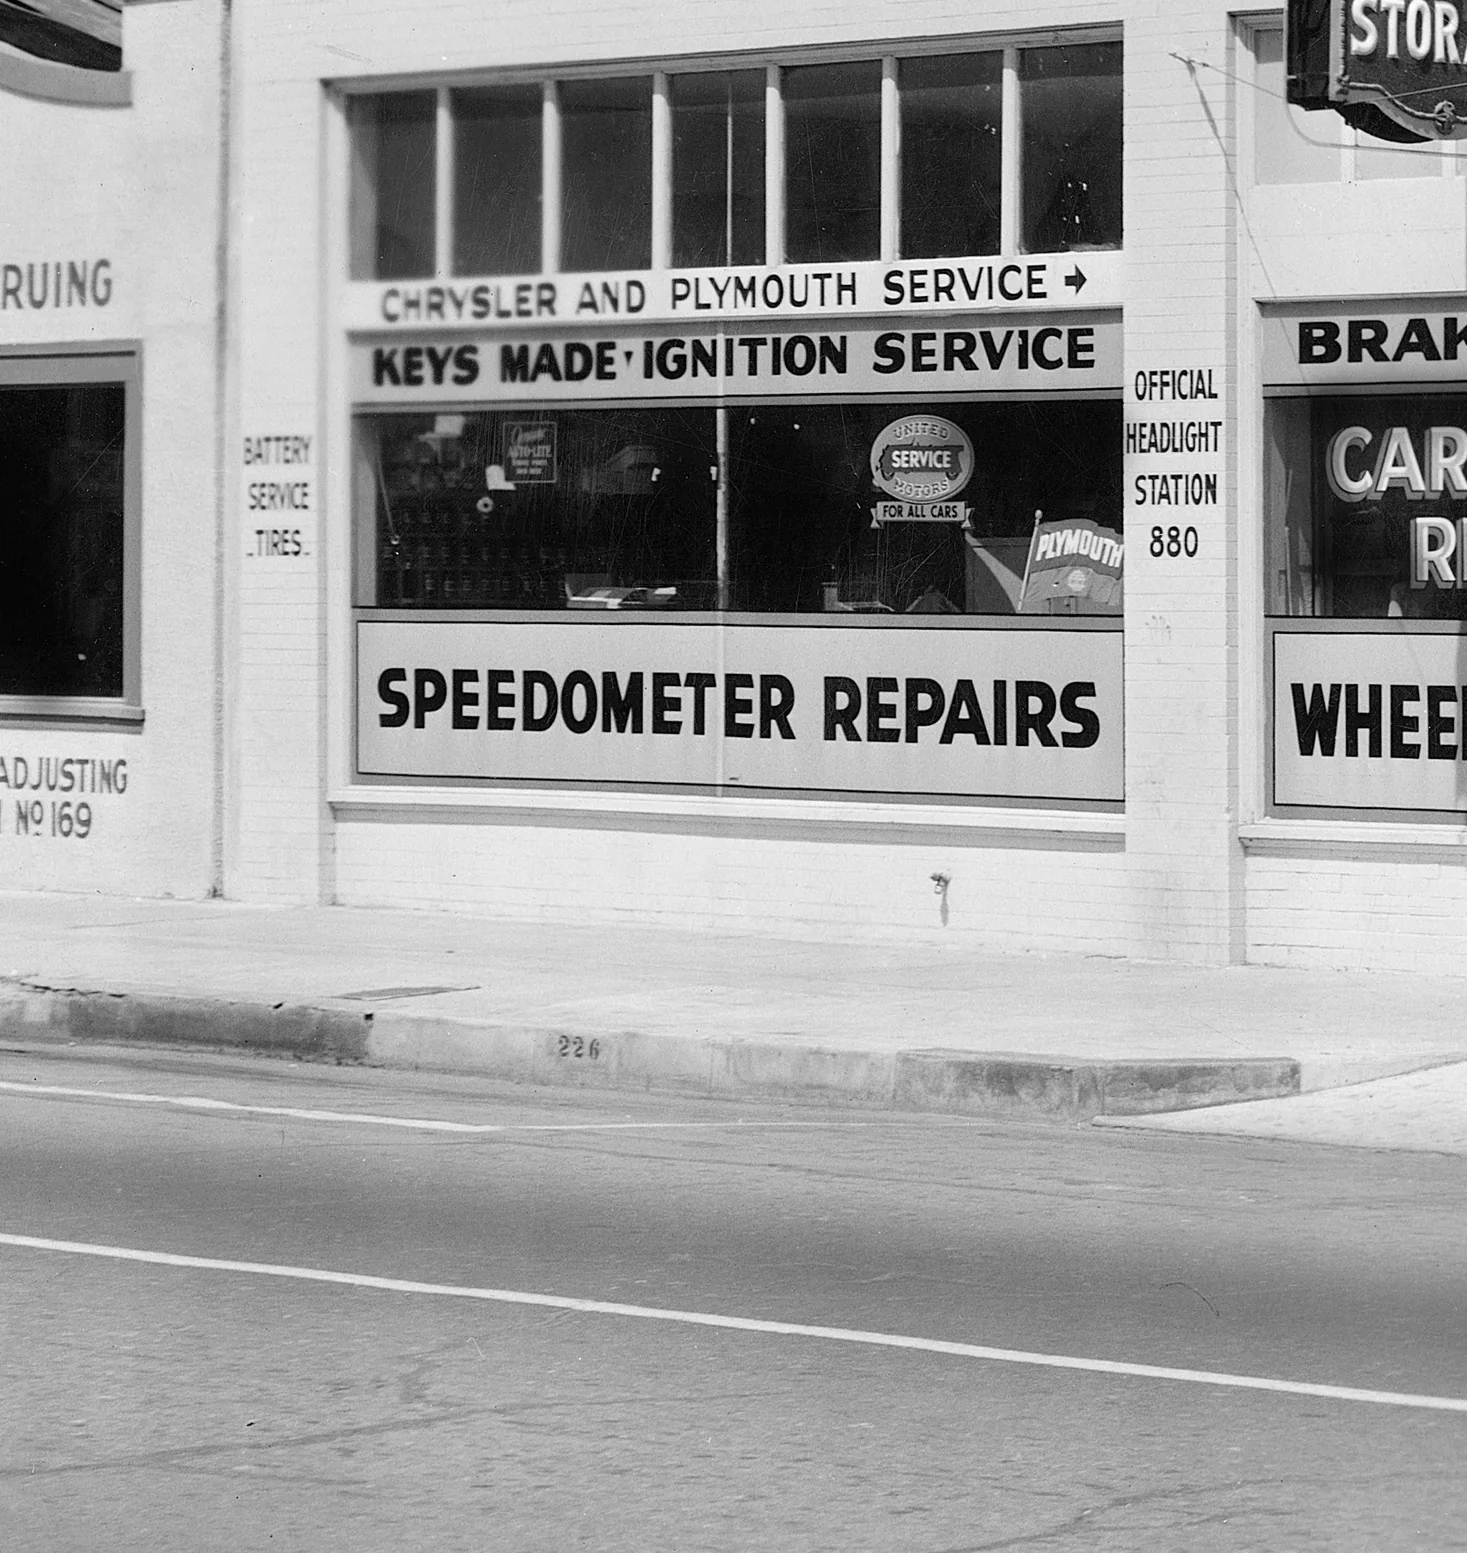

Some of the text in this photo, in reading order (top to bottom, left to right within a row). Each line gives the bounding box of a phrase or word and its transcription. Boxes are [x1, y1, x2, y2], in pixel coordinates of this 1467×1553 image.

[1, 259, 113, 310] RUING
[381, 263, 1048, 324] CHRYSLER AND PLYMOUTH SERVICE
[371, 326, 1096, 387] KEYS MADE IGNITION SERVICE
[1134, 368, 1219, 401] OFFICIAL
[892, 421, 950, 440] UNITED
[1126, 421, 1223, 454] HEADLIGHT
[242, 435, 313, 466] BATTERY
[890, 449, 953, 469] SERVICE
[247, 481, 310, 511] SERVICE
[893, 478, 950, 498] MOTORS
[1134, 473, 1218, 506] STATION
[882, 504, 958, 519] FOR ALL CARS
[1035, 528, 1124, 568] PLYMOUTH
[1149, 525, 1199, 558] 880
[377, 667, 1101, 749] SPEEDOMETER REPAIRS
[0, 756, 128, 794] ADJUSTING
[51, 801, 92, 839] 169
[558, 1034, 601, 1060] 226
